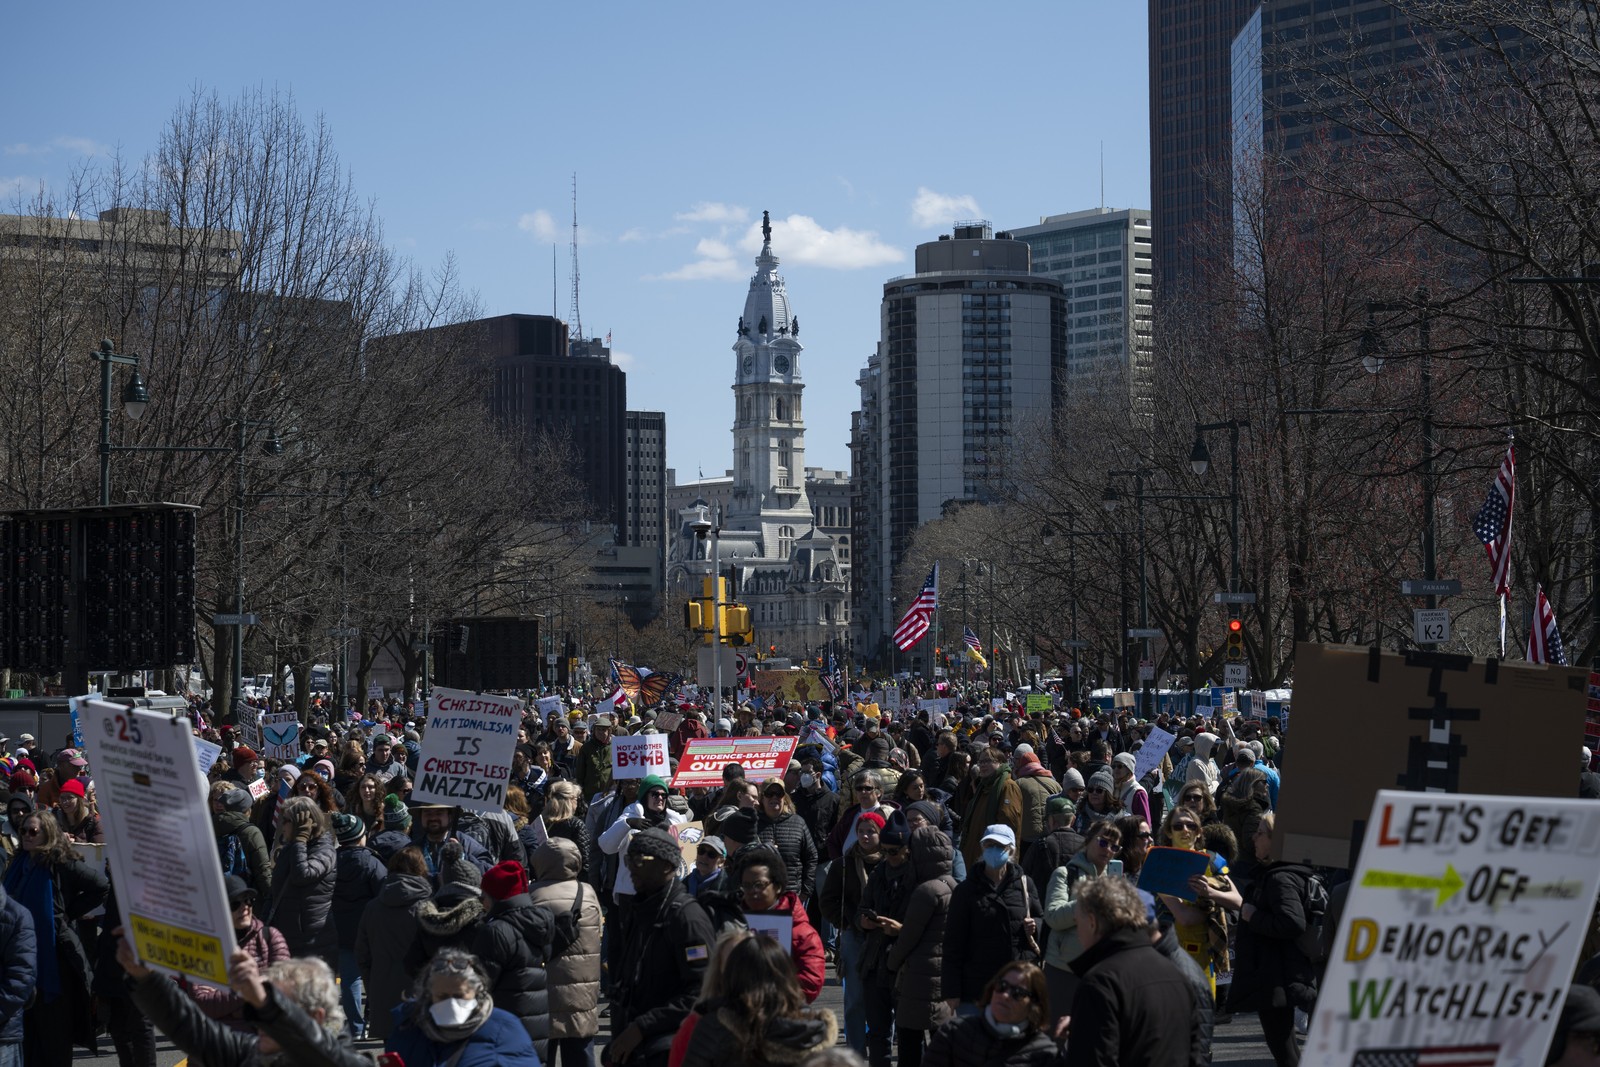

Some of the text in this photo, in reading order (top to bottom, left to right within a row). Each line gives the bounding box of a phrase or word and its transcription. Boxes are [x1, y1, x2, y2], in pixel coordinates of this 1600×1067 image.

[1424, 624, 1444, 640] K-2
[1225, 677, 1246, 685] TURNS
[1230, 668, 1242, 676] NO
[435, 693, 520, 717] “CHRISTIAN”
[431, 717, 513, 735] NATIONALISM
[453, 736, 482, 756] IS
[633, 743, 663, 751] ANOTHER
[693, 752, 780, 761] EVIDENCE-BASED
[424, 757, 510, 779] CHRIST-LESS
[420, 773, 502, 805] NAZISM
[1377, 801, 1561, 847] LET'S GET
[1467, 864, 1530, 905] OFF
[137, 921, 149, 935] We
[151, 928, 164, 938] can
[173, 934, 194, 948] must
[202, 940, 218, 954] will
[1344, 917, 1570, 974] DEMOCRACY
[146, 942, 216, 978] BUILD BACK!
[1349, 977, 1562, 1022] WATCHLIST!
